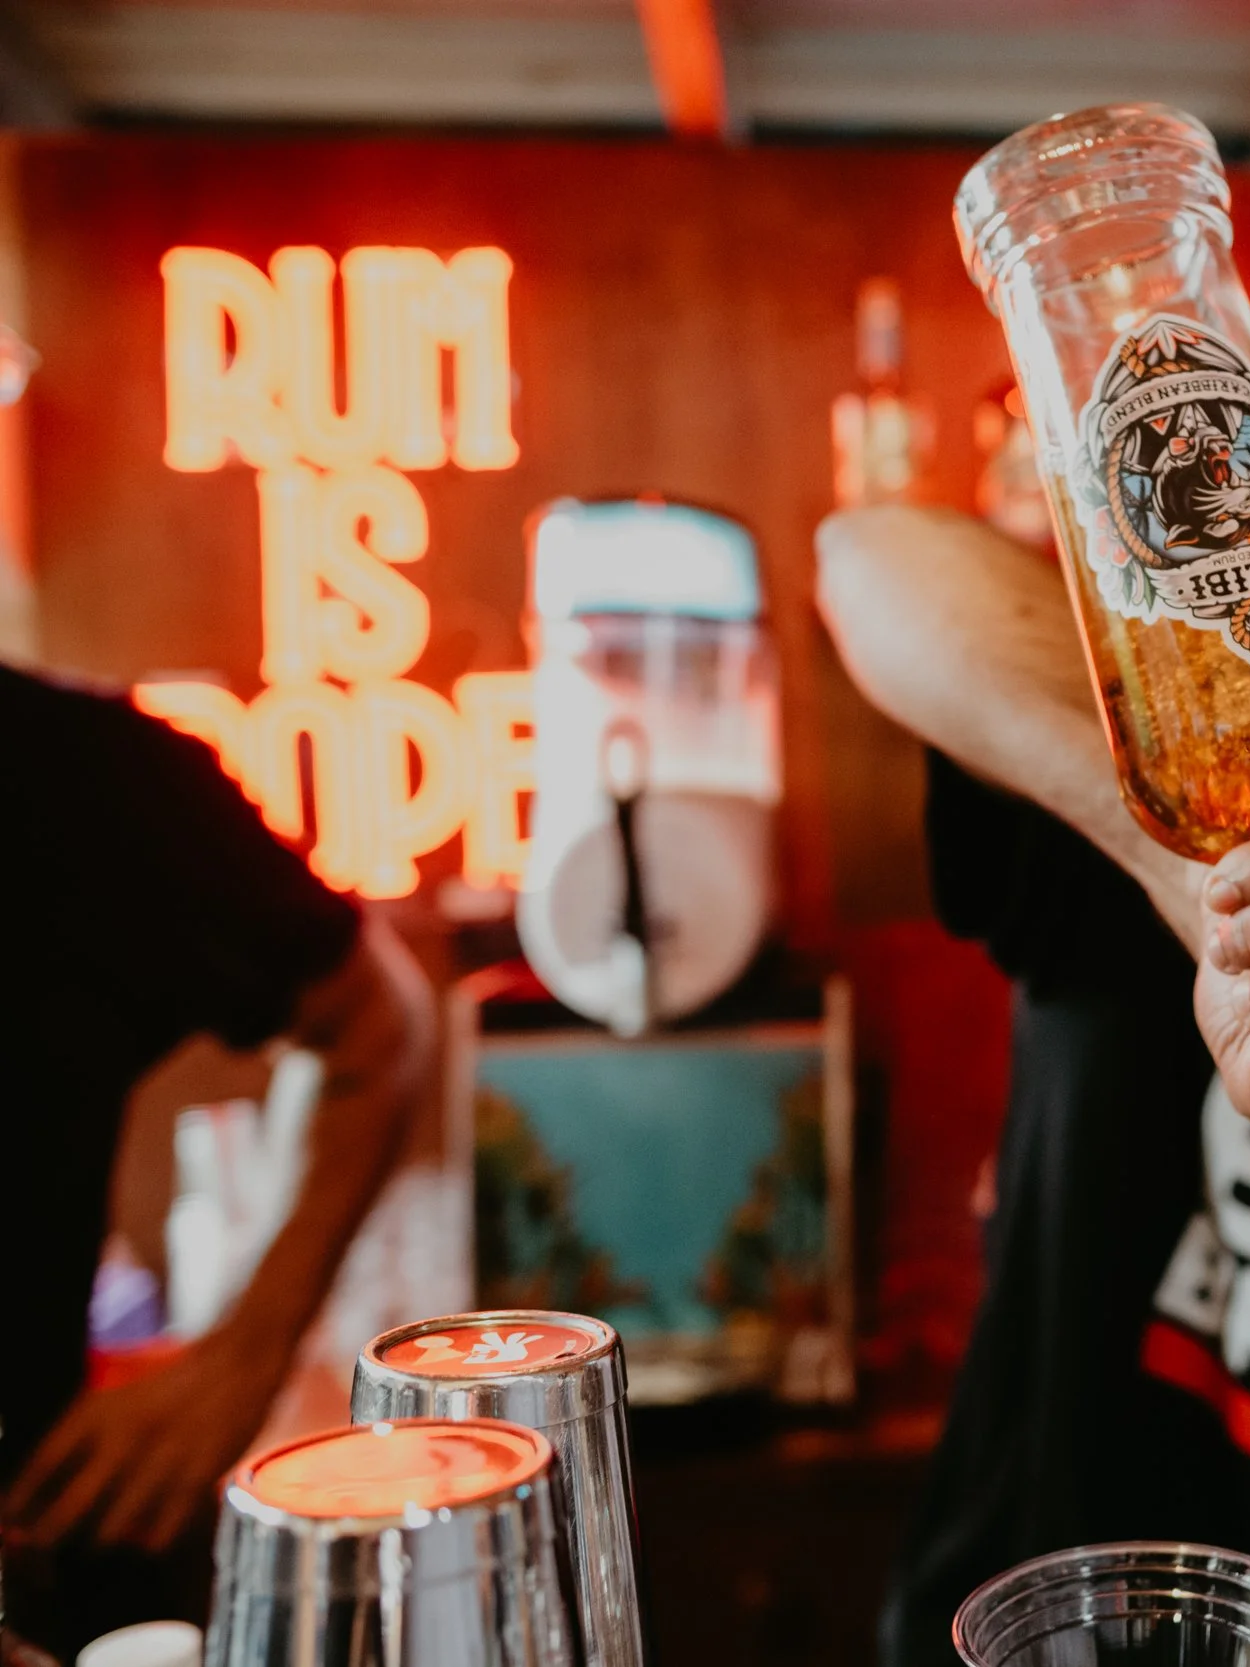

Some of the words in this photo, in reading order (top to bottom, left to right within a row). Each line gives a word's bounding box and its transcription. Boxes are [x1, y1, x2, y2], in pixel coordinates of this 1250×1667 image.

[160, 245, 520, 473] RUM
[1107, 393, 1154, 427] BLEND
[1157, 379, 1250, 400] CARIBBEAN
[258, 462, 431, 688] IS
[1213, 555, 1237, 566] RUM
[132, 671, 537, 900] OPE
